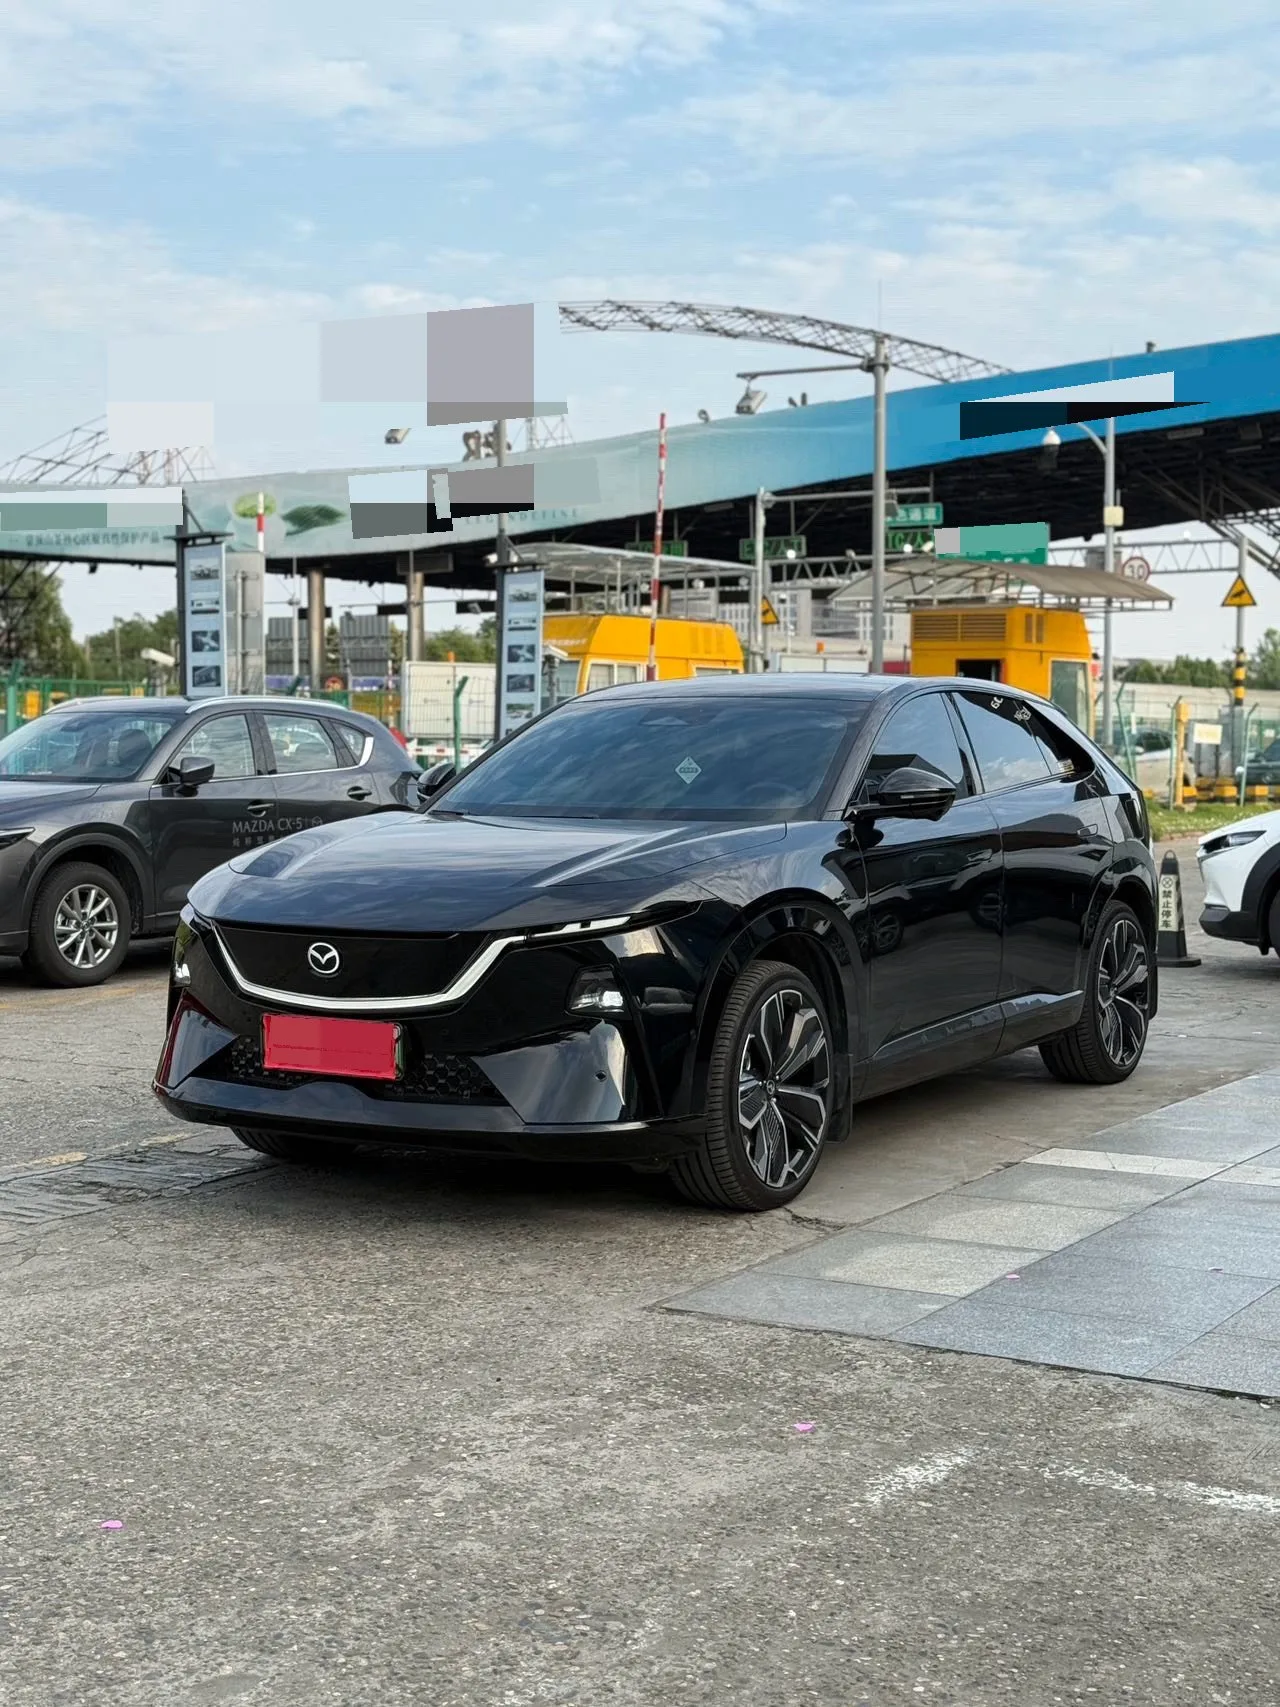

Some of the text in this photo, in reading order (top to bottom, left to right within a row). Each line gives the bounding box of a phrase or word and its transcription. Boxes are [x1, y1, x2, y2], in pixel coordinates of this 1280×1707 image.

[887, 507, 937, 522] 色通道
[1126, 564, 1144, 580] 30
[232, 817, 303, 833] MAZDA CX-5
[1160, 889, 1173, 929] 禁止停车
